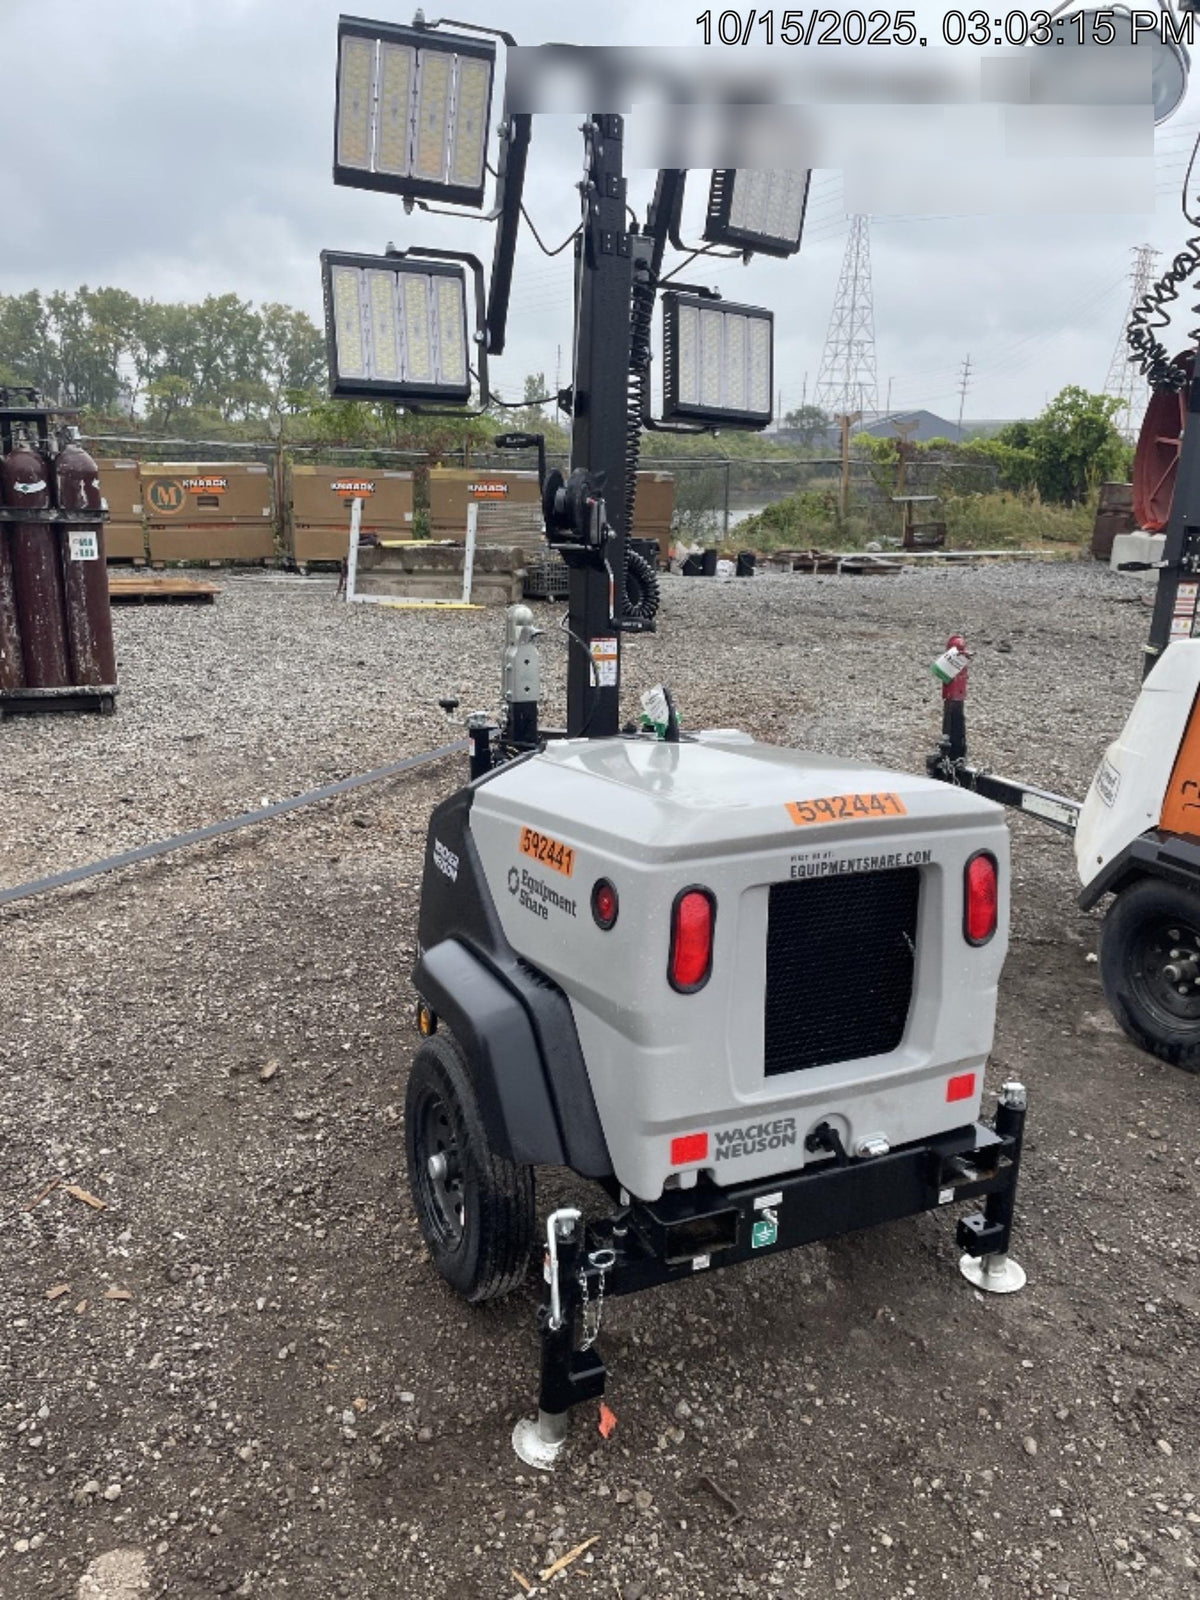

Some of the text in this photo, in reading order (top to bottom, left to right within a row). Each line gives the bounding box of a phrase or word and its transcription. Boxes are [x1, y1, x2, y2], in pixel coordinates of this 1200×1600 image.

[157, 486, 177, 506] M
[796, 793, 901, 822] 592441
[523, 828, 574, 876] 592441
[790, 850, 932, 878] EQUIPMENTSHARE.COM
[519, 890, 549, 920] Share
[521, 868, 577, 918] Equipment
[715, 1117, 796, 1146] WACKER
[715, 1131, 797, 1161] NEUSON
